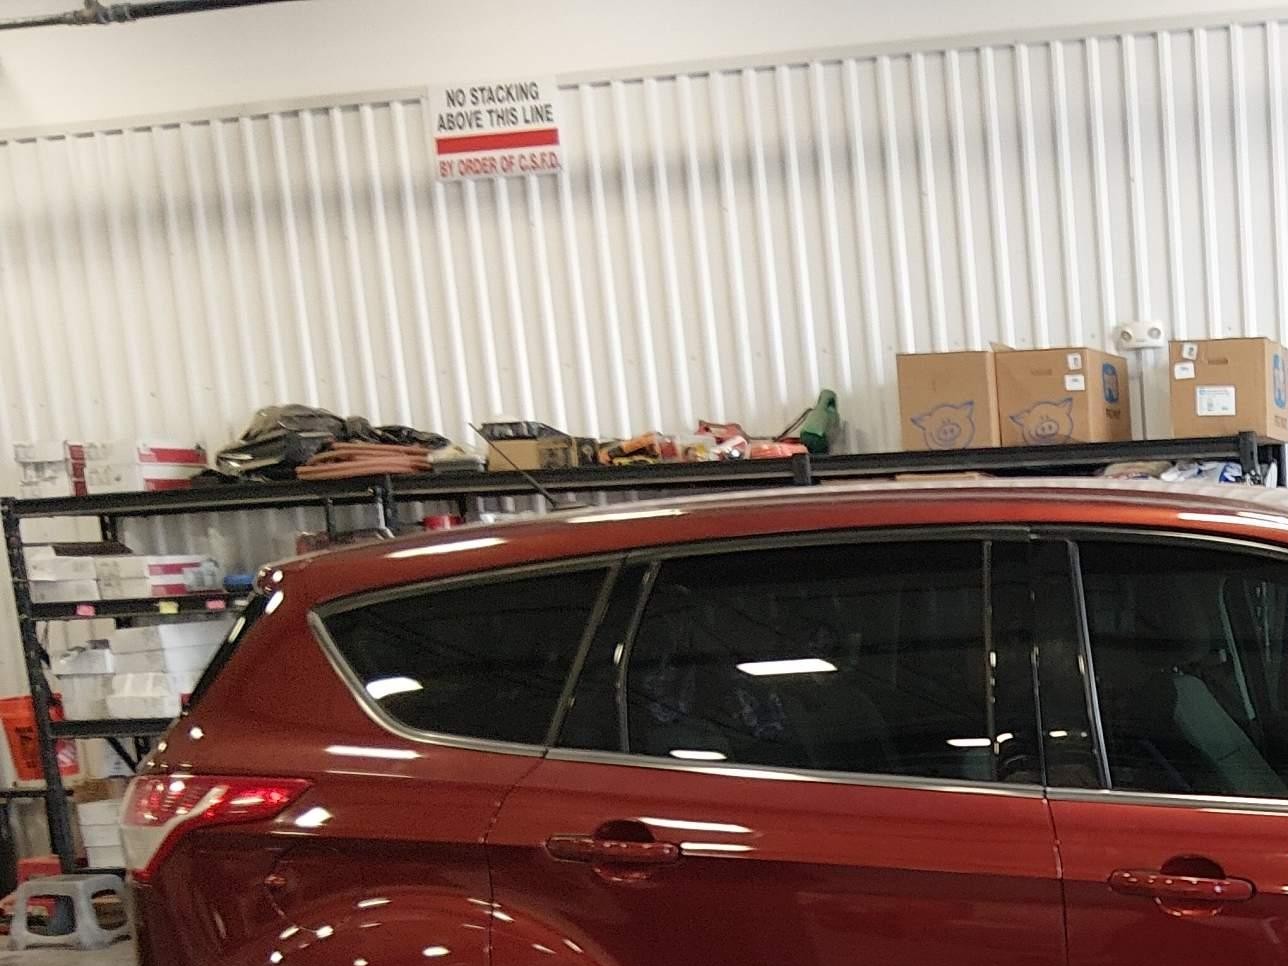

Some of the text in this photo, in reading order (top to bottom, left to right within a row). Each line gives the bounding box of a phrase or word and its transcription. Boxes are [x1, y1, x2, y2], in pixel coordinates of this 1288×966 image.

[446, 82, 540, 108] NO STACKING
[438, 103, 554, 131] ABOVE THIS LINE
[440, 160, 453, 177] BY
[459, 156, 497, 176] ORDER
[501, 155, 514, 173] OF
